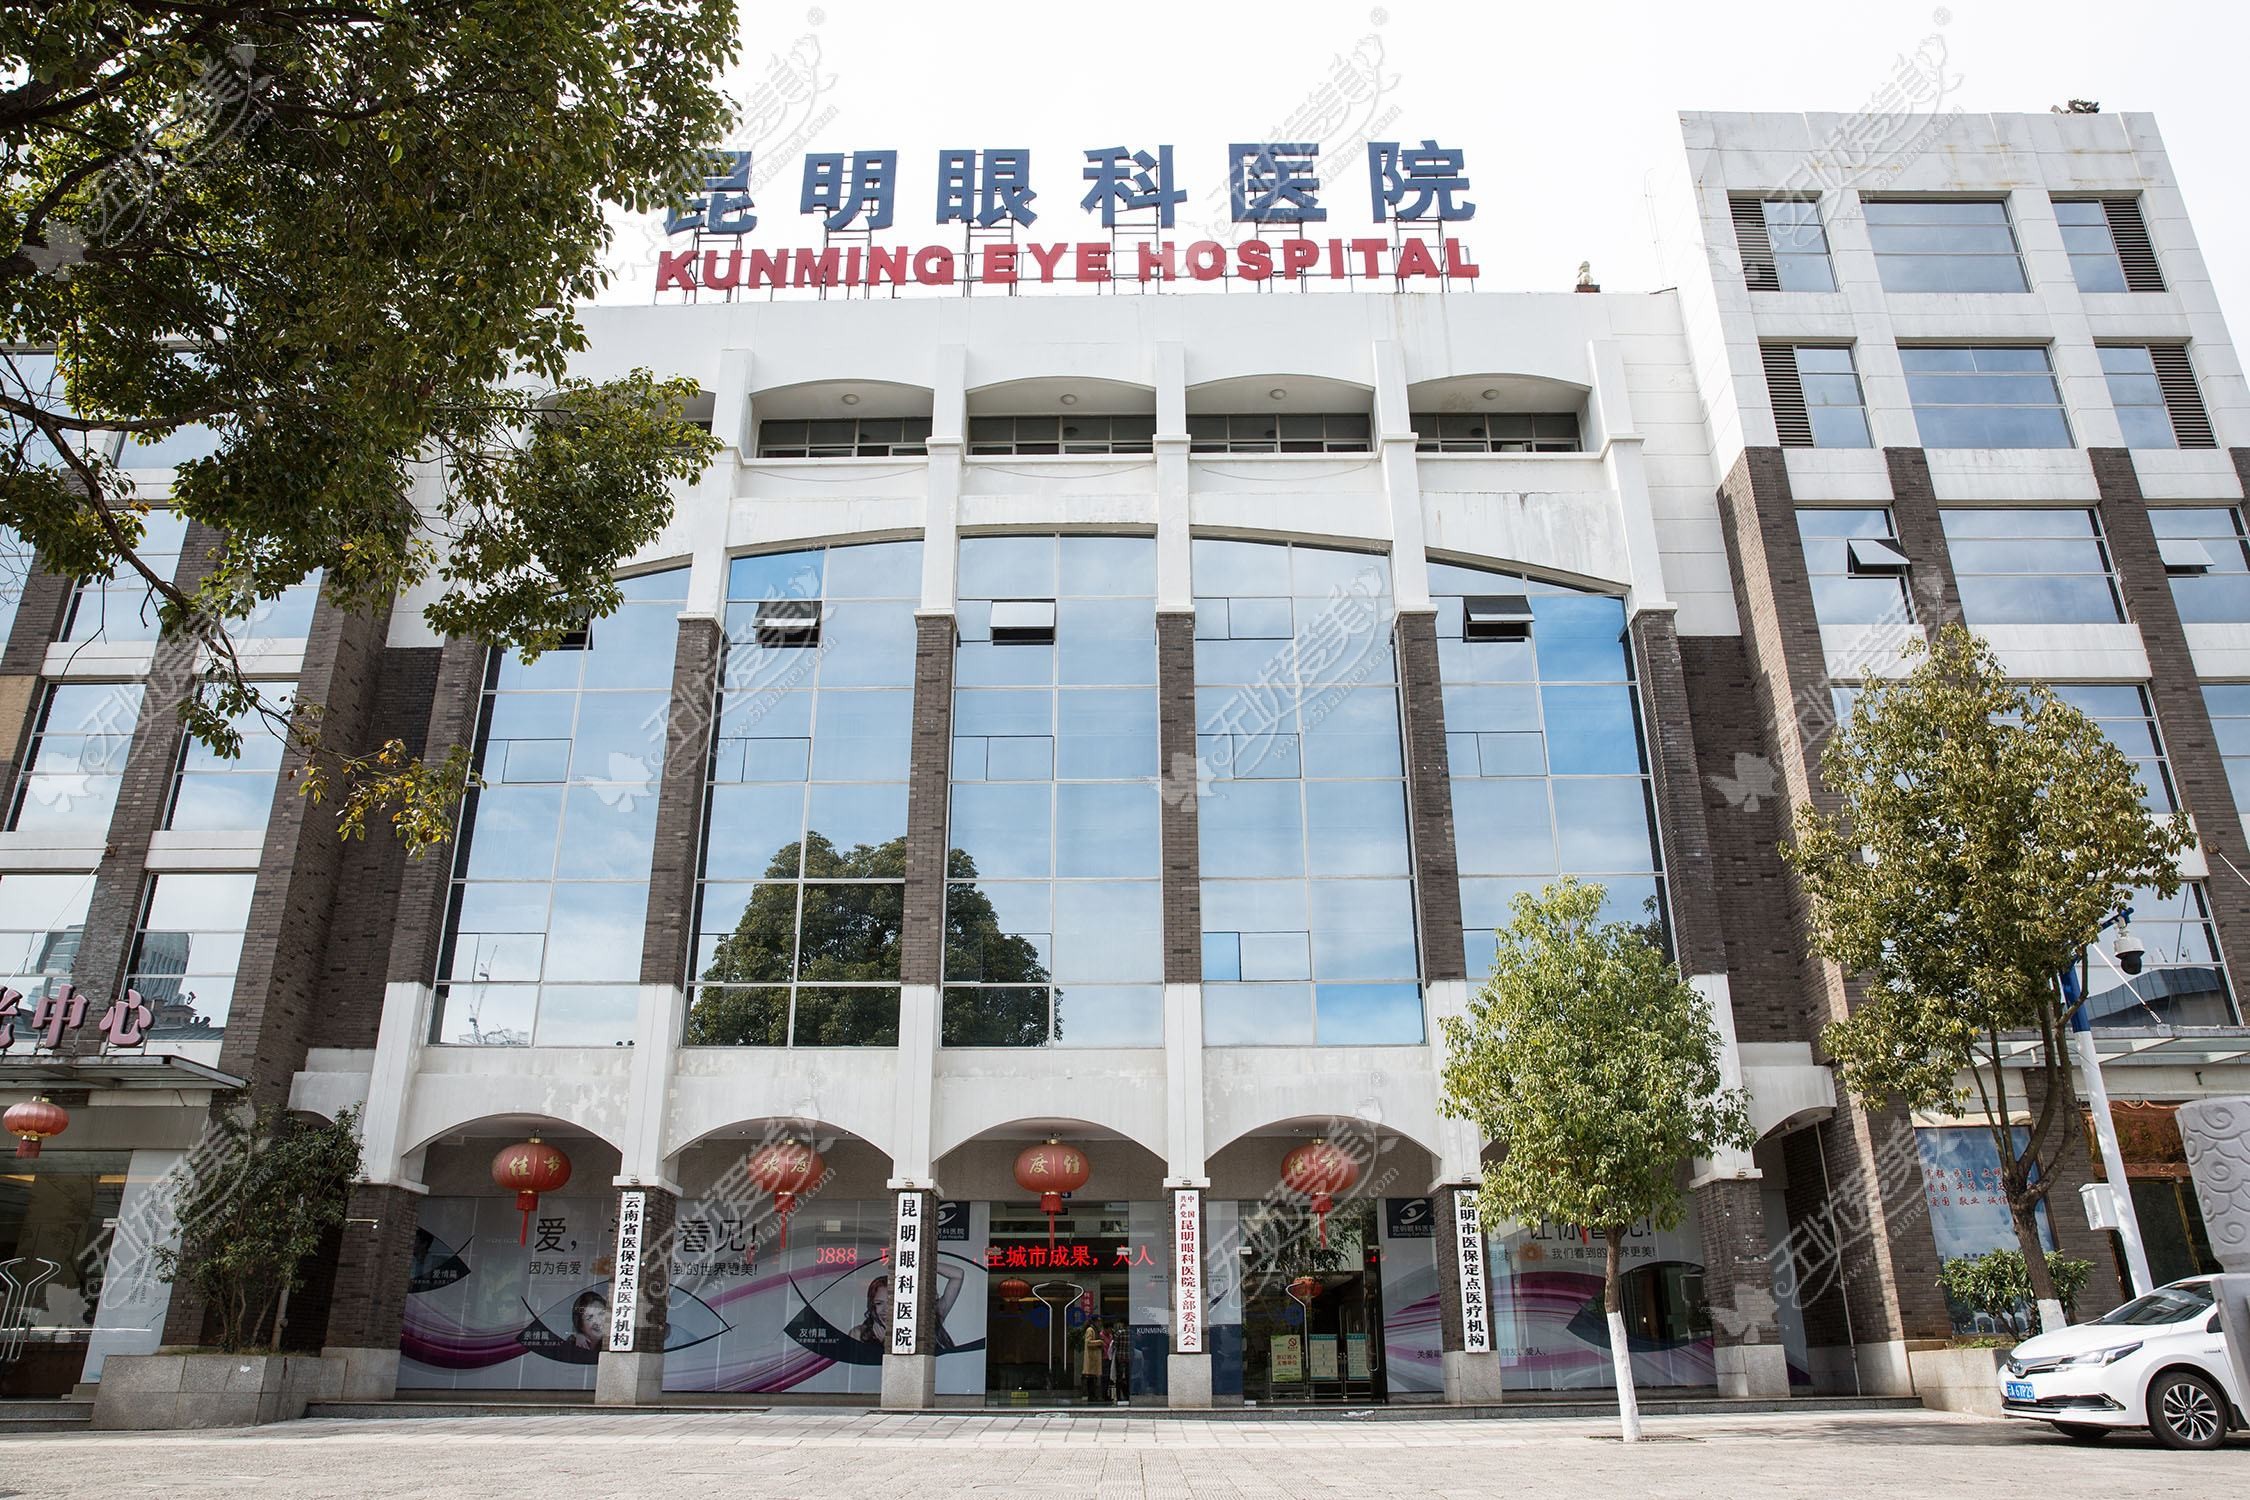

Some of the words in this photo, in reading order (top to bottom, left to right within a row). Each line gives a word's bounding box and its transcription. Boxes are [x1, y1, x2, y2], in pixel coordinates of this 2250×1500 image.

[663, 139, 1477, 236] 昆明眼科医院
[655, 244, 954, 292] KUNMING
[982, 240, 1112, 283] EYE
[1139, 236, 1480, 282] HOSPITAL
[528, 1260, 582, 1276] 因为有爱
[612, 1194, 644, 1347] 云南省医保定点医疗机构
[894, 1198, 919, 1348] 昆明眼科医院
[1180, 1219, 1198, 1347] 昆明眼科医院支部委员会
[1458, 1195, 1486, 1347] 昆明市医保定点医疗机构
[1551, 1246, 1656, 1260] 我们看到的界更美!
